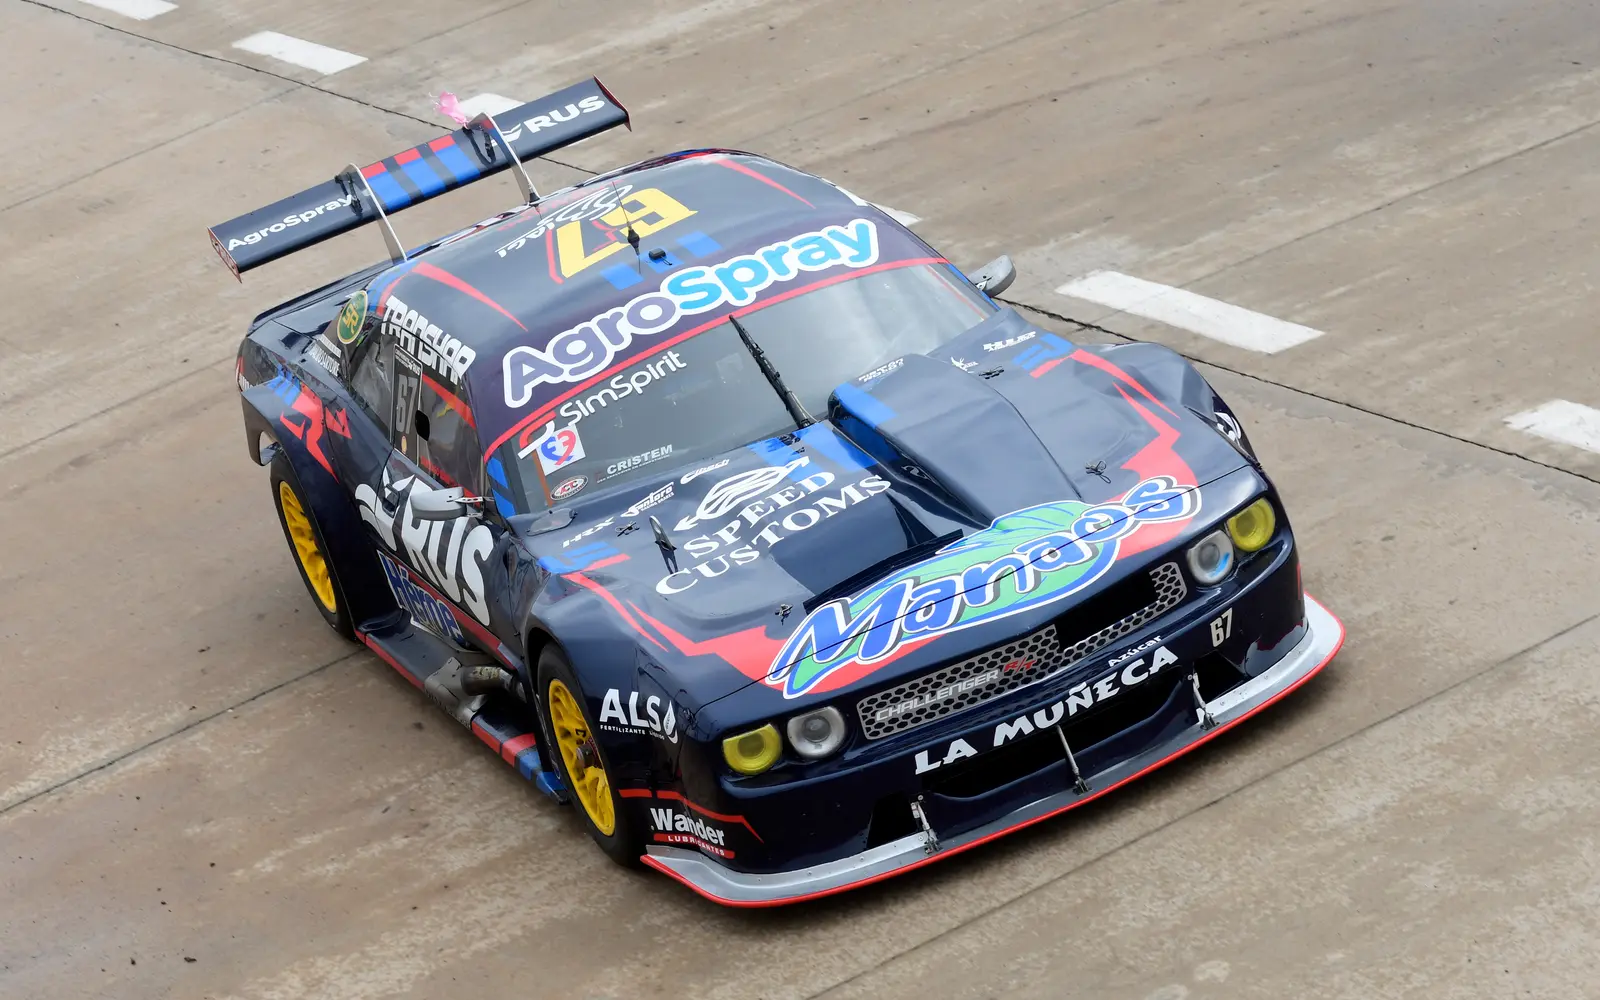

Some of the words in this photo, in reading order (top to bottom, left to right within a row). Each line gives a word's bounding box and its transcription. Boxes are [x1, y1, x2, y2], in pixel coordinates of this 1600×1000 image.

[227, 194, 352, 251] AgroSpray
[502, 218, 879, 409] AgroSpray
[395, 373, 419, 435] 67
[559, 350, 687, 427] SimSpirit
[606, 444, 673, 475] CRISTEM
[655, 474, 892, 595] CUSTOMS
[683, 471, 836, 559] SPEED
[765, 475, 1203, 699] Manaos
[1107, 635, 1162, 668] Azúcar
[1209, 607, 1233, 648] 67
[876, 668, 999, 722] CHALLENGER
[1003, 657, 1036, 674] R/T
[915, 738, 978, 776] LA
[993, 645, 1179, 747] MUÑECA
[649, 807, 725, 847] Wander
[667, 834, 726, 857] LUBRICANTES
